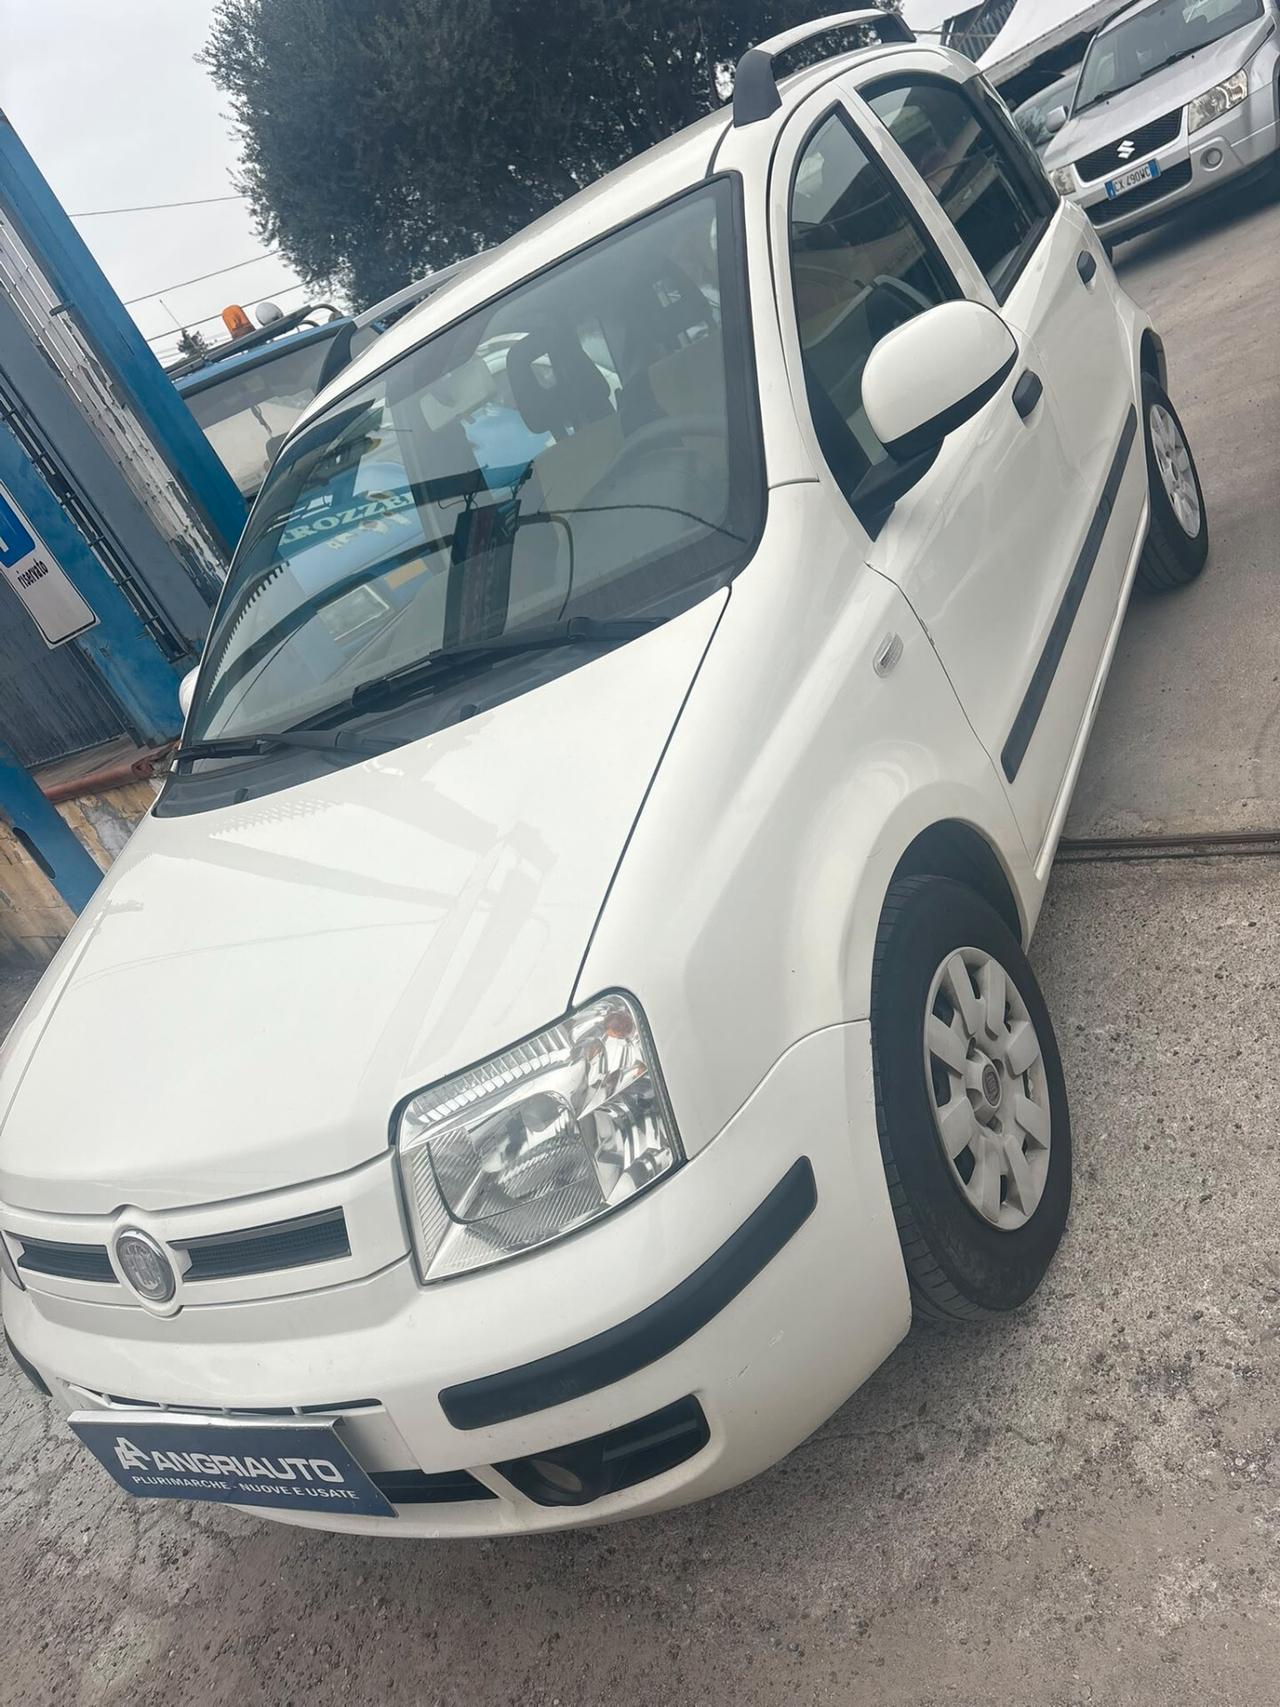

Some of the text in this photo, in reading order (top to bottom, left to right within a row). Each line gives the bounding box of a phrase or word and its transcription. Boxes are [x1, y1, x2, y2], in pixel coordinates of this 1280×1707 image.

[16, 558, 49, 590] riservato
[151, 1451, 345, 1483] ANGRIAUTO
[132, 1476, 232, 1490] PLURIMARCHE
[239, 1483, 292, 1495] NUOVE
[292, 1487, 305, 1495] E
[305, 1487, 360, 1499] USATE
